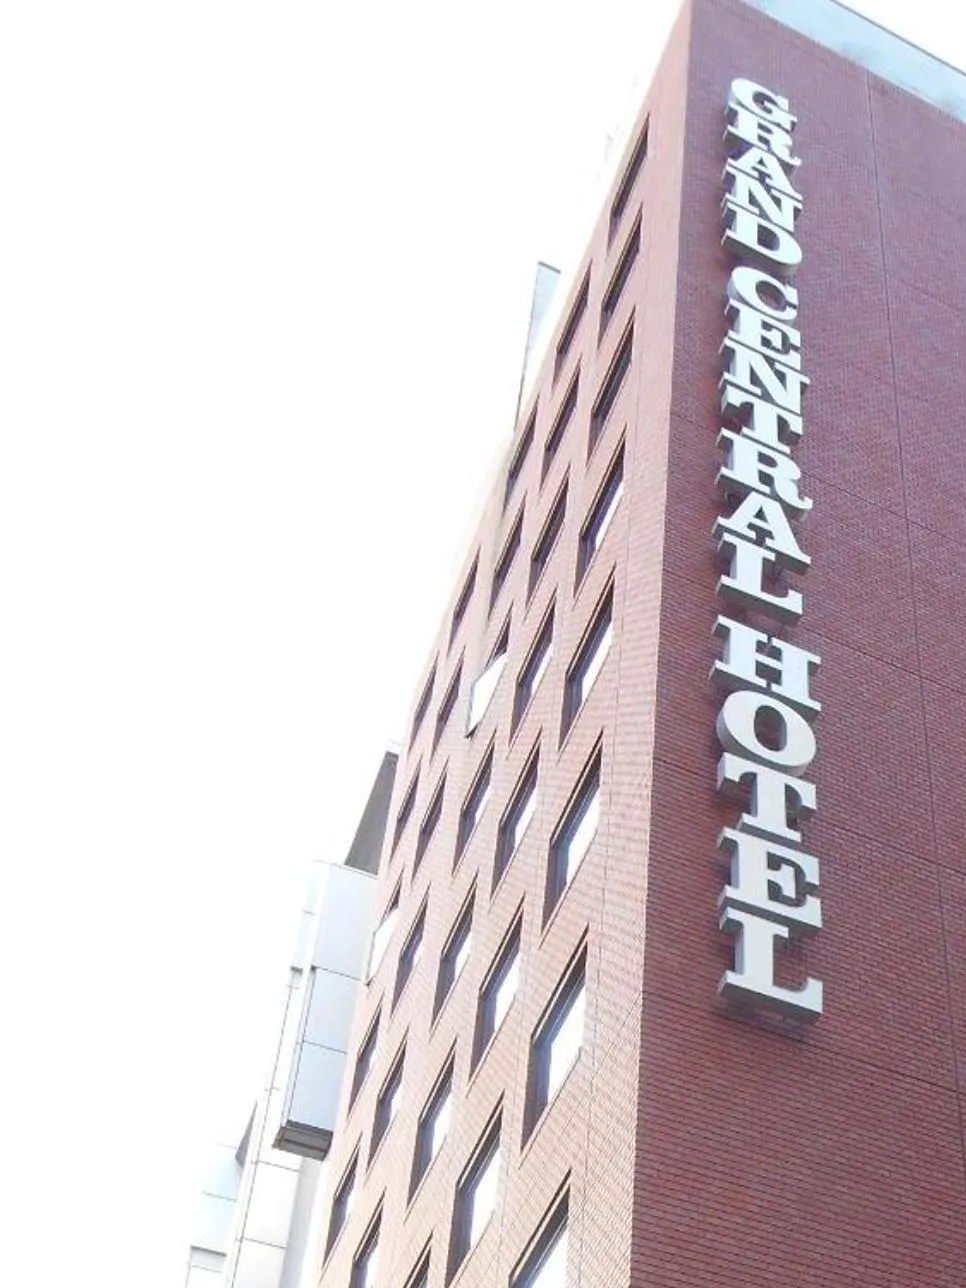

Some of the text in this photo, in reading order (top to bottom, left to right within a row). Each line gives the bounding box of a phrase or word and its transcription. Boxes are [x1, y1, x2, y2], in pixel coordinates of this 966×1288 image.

[709, 77, 823, 1023] GRAND CENTRAL HOTEL
